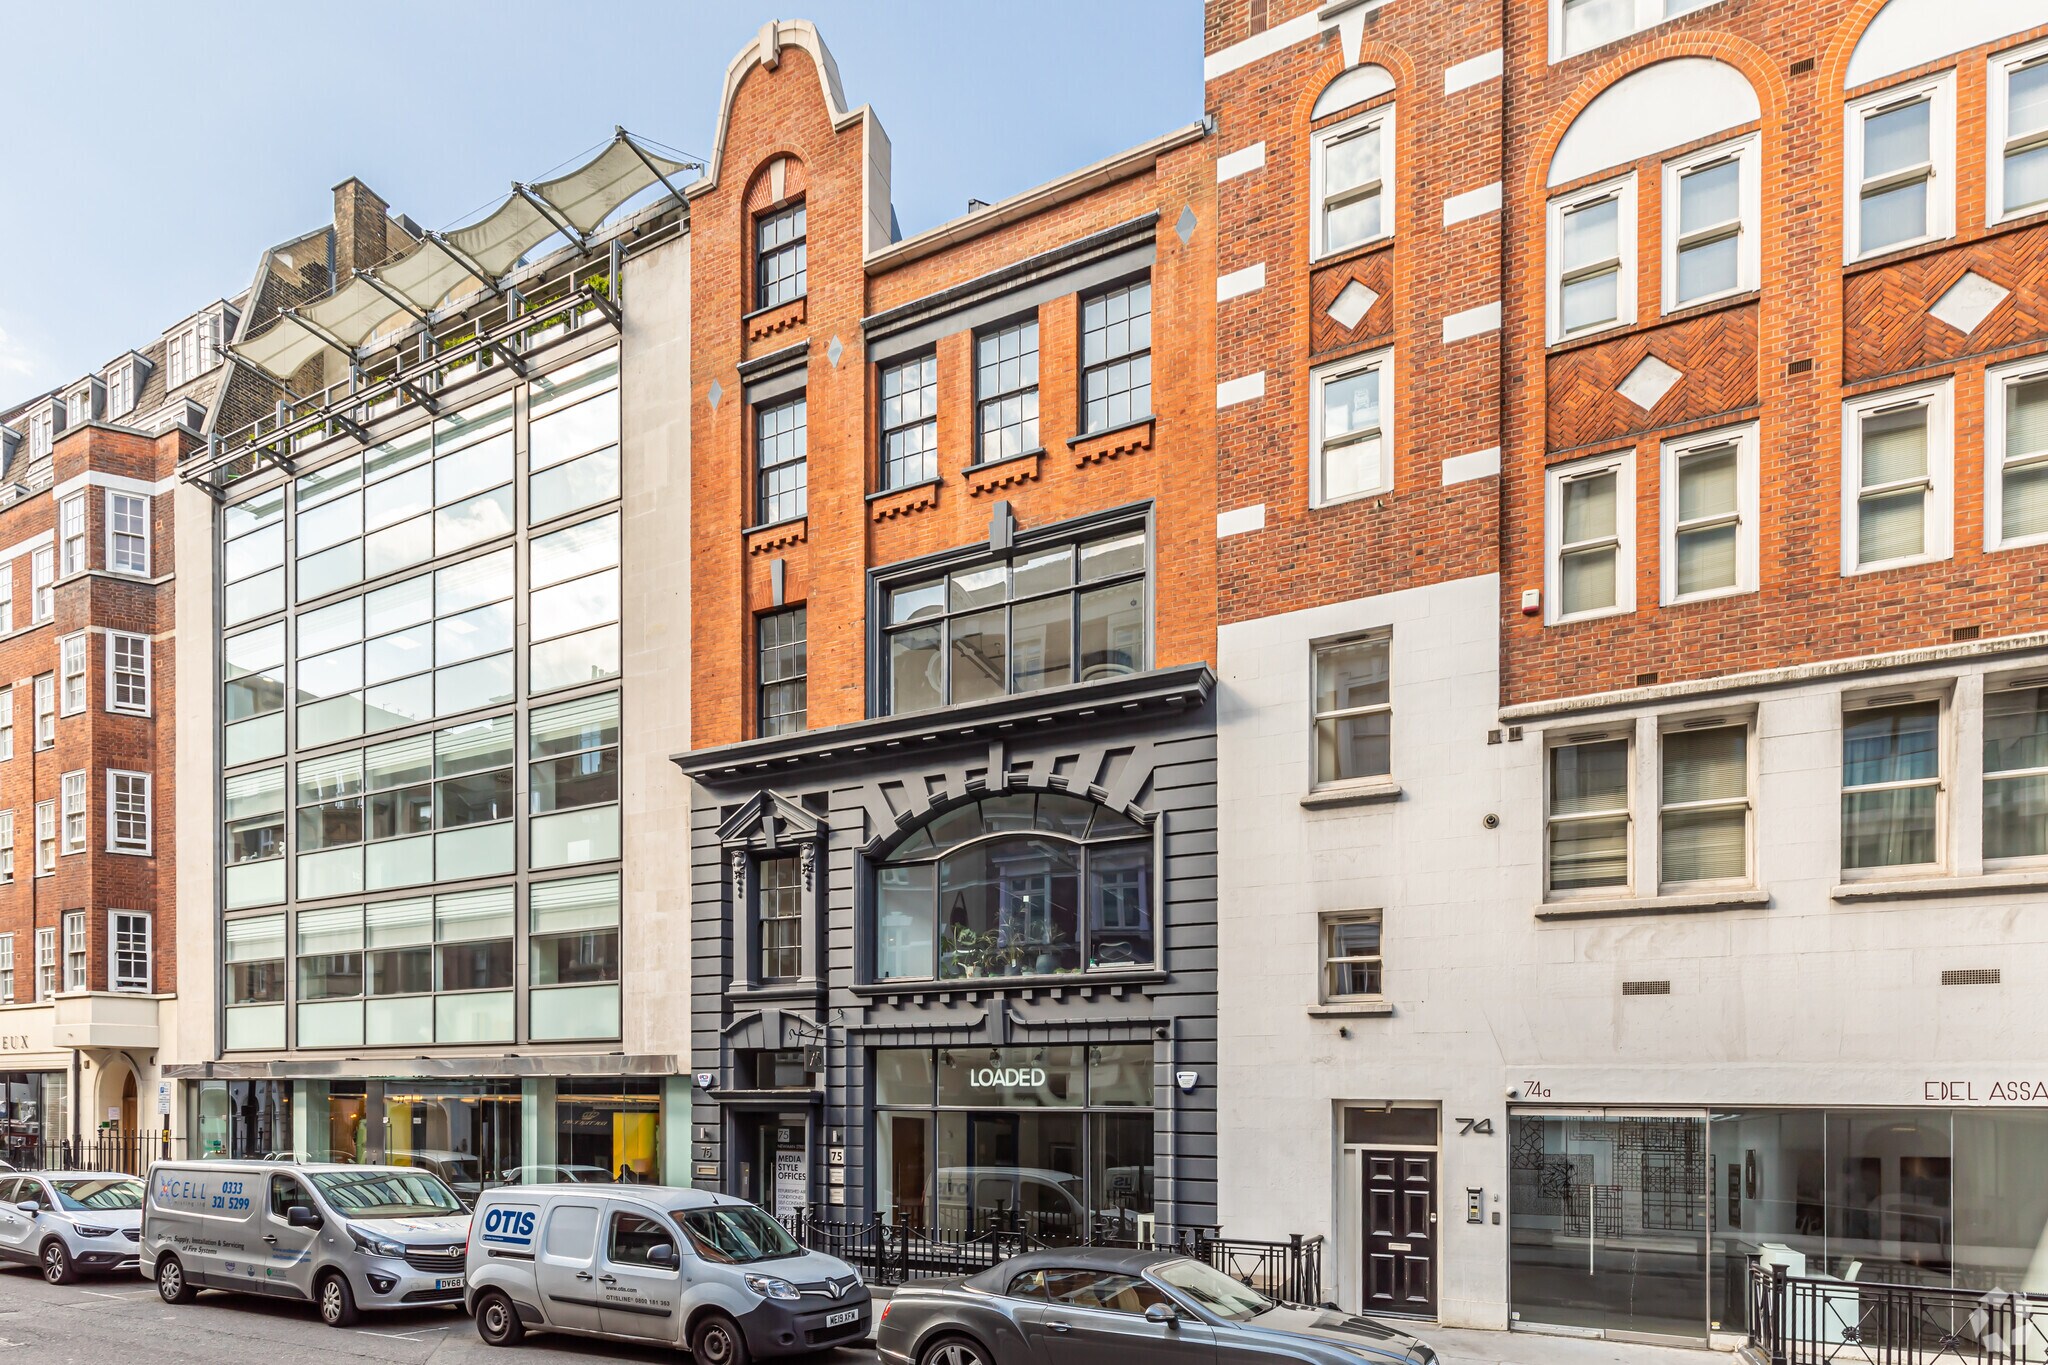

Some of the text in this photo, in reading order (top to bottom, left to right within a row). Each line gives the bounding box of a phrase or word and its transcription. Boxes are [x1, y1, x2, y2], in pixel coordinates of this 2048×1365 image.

[2, 1035, 29, 1050] EUX
[970, 1068, 1046, 1087] LOADED
[1523, 1080, 1551, 1098] 74a
[1924, 1081, 2048, 1101] EDEL ASSA
[1455, 1117, 1494, 1136] 74
[778, 1130, 789, 1140] 75
[777, 1154, 802, 1163] MEDIA
[831, 1151, 843, 1161] 75
[777, 1163, 799, 1172] STYLE
[777, 1172, 806, 1181] OFFICES
[222, 1181, 243, 1195] 0333
[211, 1196, 250, 1210] 321 5299
[485, 1209, 536, 1235] OTIS
[198, 1247, 218, 1255] Systems
[222, 1239, 245, 1251] Servicing
[441, 1279, 461, 1288] DV68
[605, 1285, 637, 1293] www.otis.com
